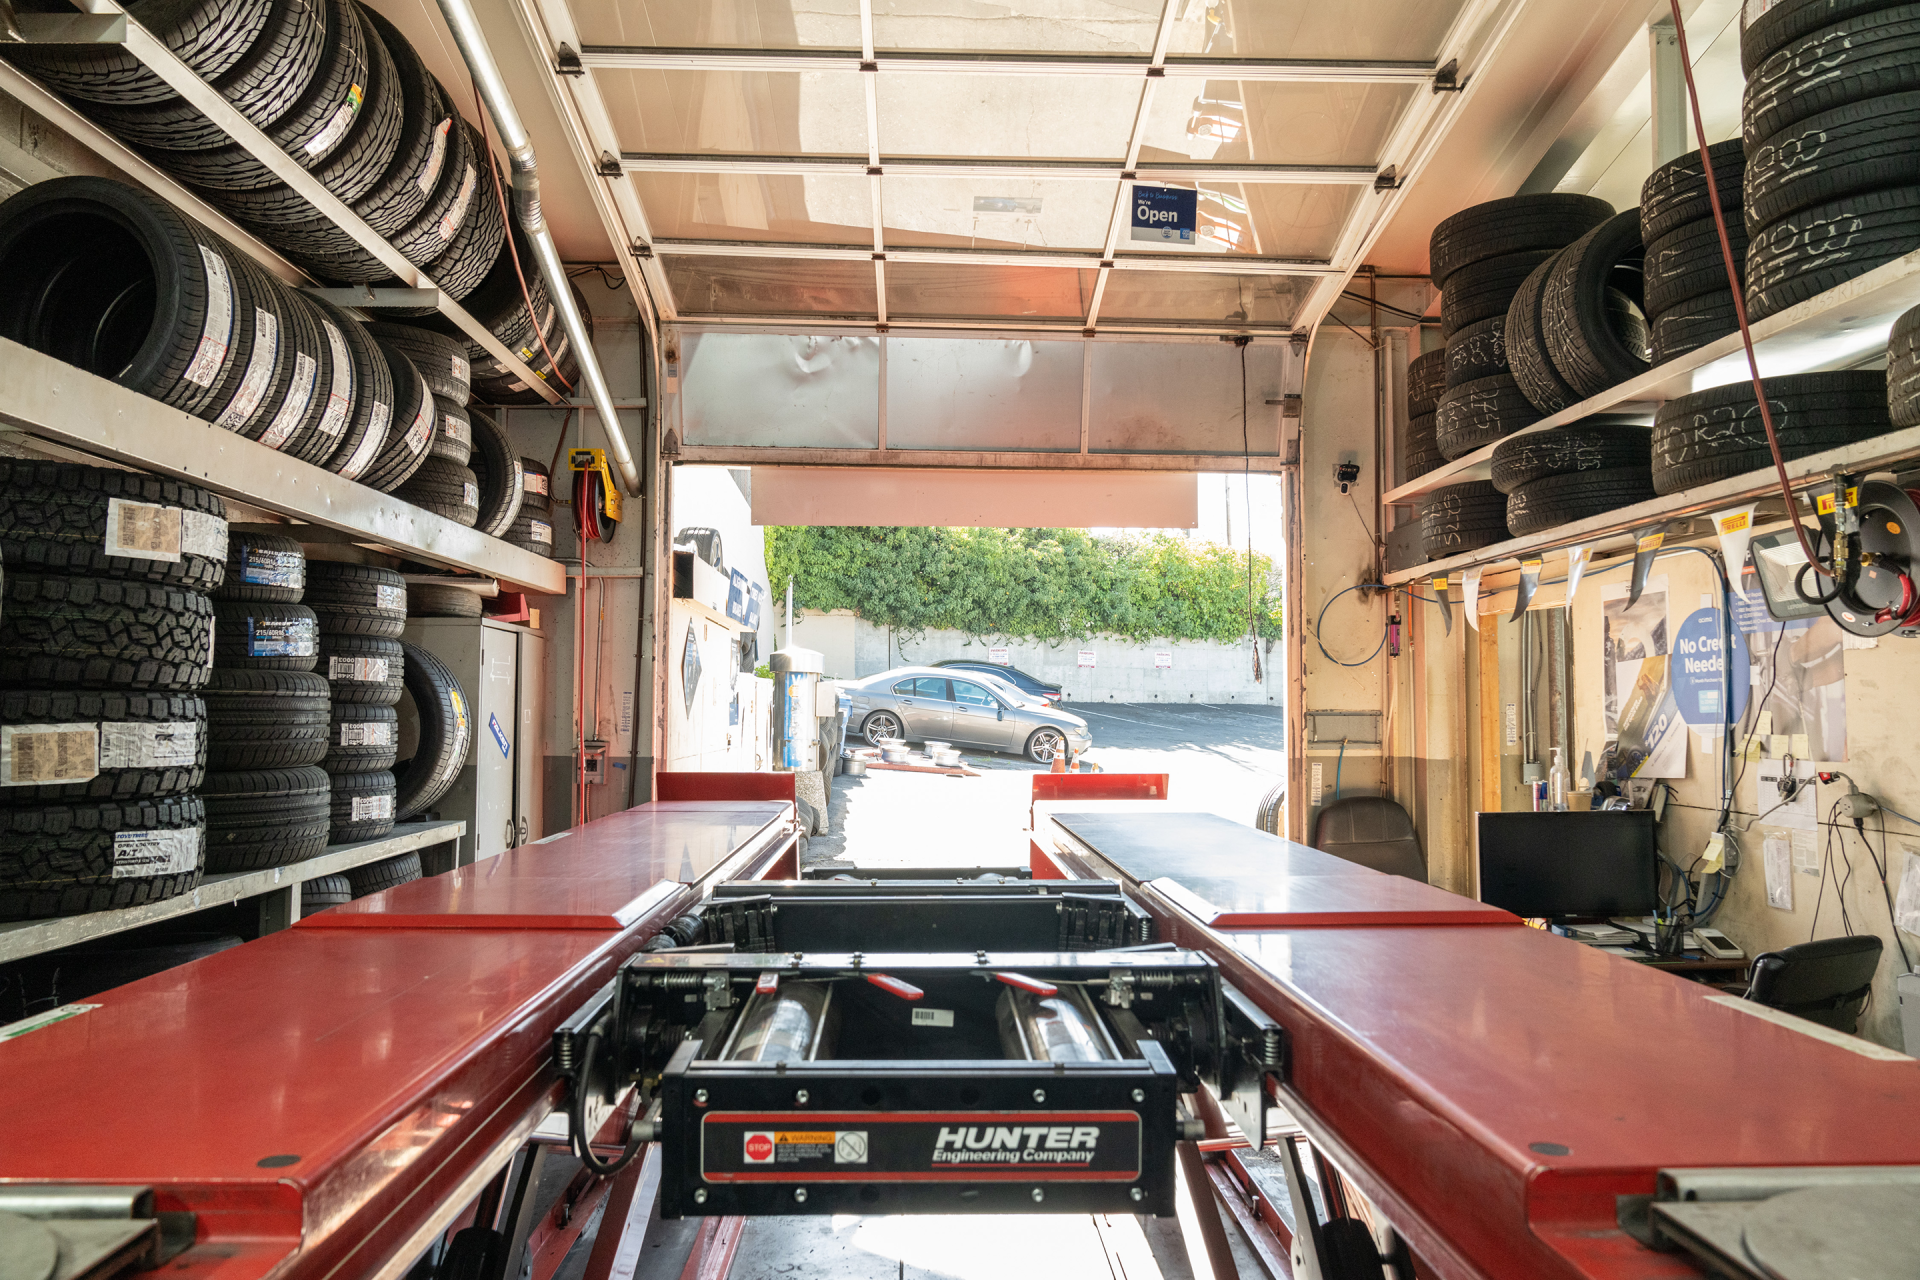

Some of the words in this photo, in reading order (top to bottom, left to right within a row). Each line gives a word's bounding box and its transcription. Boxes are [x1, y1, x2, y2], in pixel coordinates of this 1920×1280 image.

[1137, 205, 1178, 224] Open
[1720, 515, 1746, 533] PIRELLI
[1640, 534, 1662, 551] PIRELLI
[1698, 616, 1713, 624] acima
[1680, 638, 1697, 654] No
[1698, 634, 1737, 652] Cret
[1685, 655, 1723, 674] Neede
[1644, 713, 1668, 750] $120
[791, 1134, 832, 1142] WARNING
[935, 1126, 1100, 1149] HUNTER
[748, 1143, 771, 1152] STOP
[932, 1149, 1020, 1163] Engineering
[1022, 1149, 1095, 1163] Company
